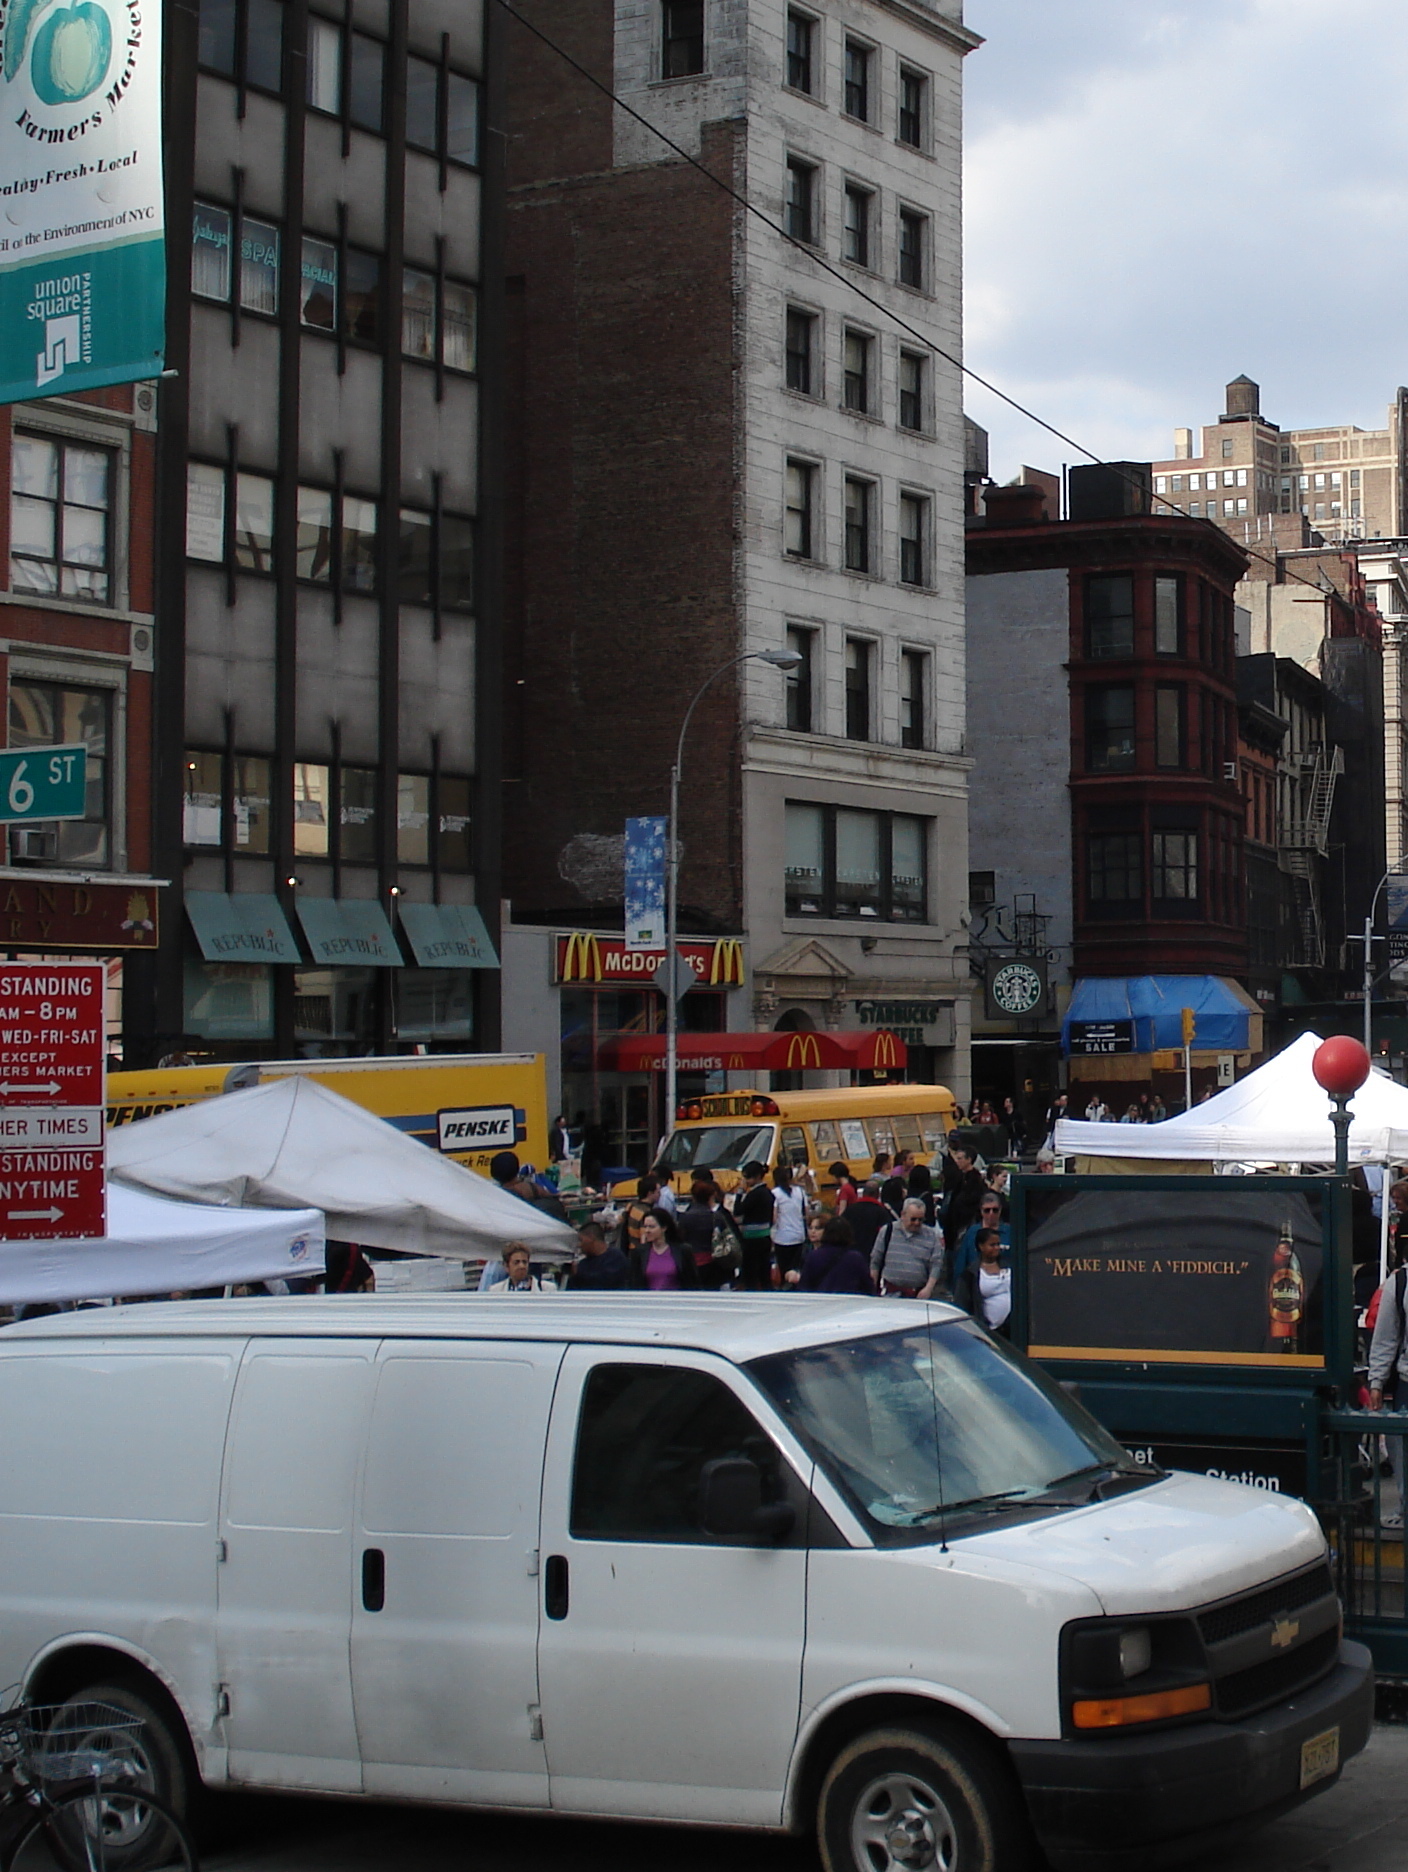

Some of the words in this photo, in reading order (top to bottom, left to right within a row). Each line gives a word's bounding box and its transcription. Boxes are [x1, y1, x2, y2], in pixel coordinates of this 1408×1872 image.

[15, 109, 103, 144] Farmers
[46, 164, 88, 185] Fresh
[97, 150, 138, 174] Local
[44, 216, 114, 242] Environment
[115, 211, 128, 225] of
[129, 206, 155, 223] NYC
[241, 238, 277, 268] SPA
[35, 274, 81, 299] union
[27, 293, 81, 321] square
[82, 272, 92, 364] PARTNERSHIP
[49, 755, 75, 784] ST
[211, 934, 284, 956] REPUBLIC
[321, 937, 388, 958] REPUBLIC
[424, 942, 484, 960] REPUBLIC
[1, 976, 93, 996] STANDING
[995, 966, 1039, 988] STARBUCKS
[40, 1001, 53, 1020] 8
[56, 1007, 77, 1020] PM
[1000, 997, 1034, 1011] COFFEE
[860, 1006, 938, 1024] STARBUCKS
[2, 1029, 98, 1045] WED-FRI-SAT
[1085, 1042, 1116, 1052] SALE
[1, 1052, 57, 1063] EXCEPT
[36, 1065, 94, 1077] MARKET
[37, 1118, 89, 1135] TIMES
[444, 1118, 511, 1139] PENSKE
[2, 1152, 94, 1173] STANDING
[1107, 1259, 1147, 1273] MINE
[1152, 1260, 1163, 1274] A
